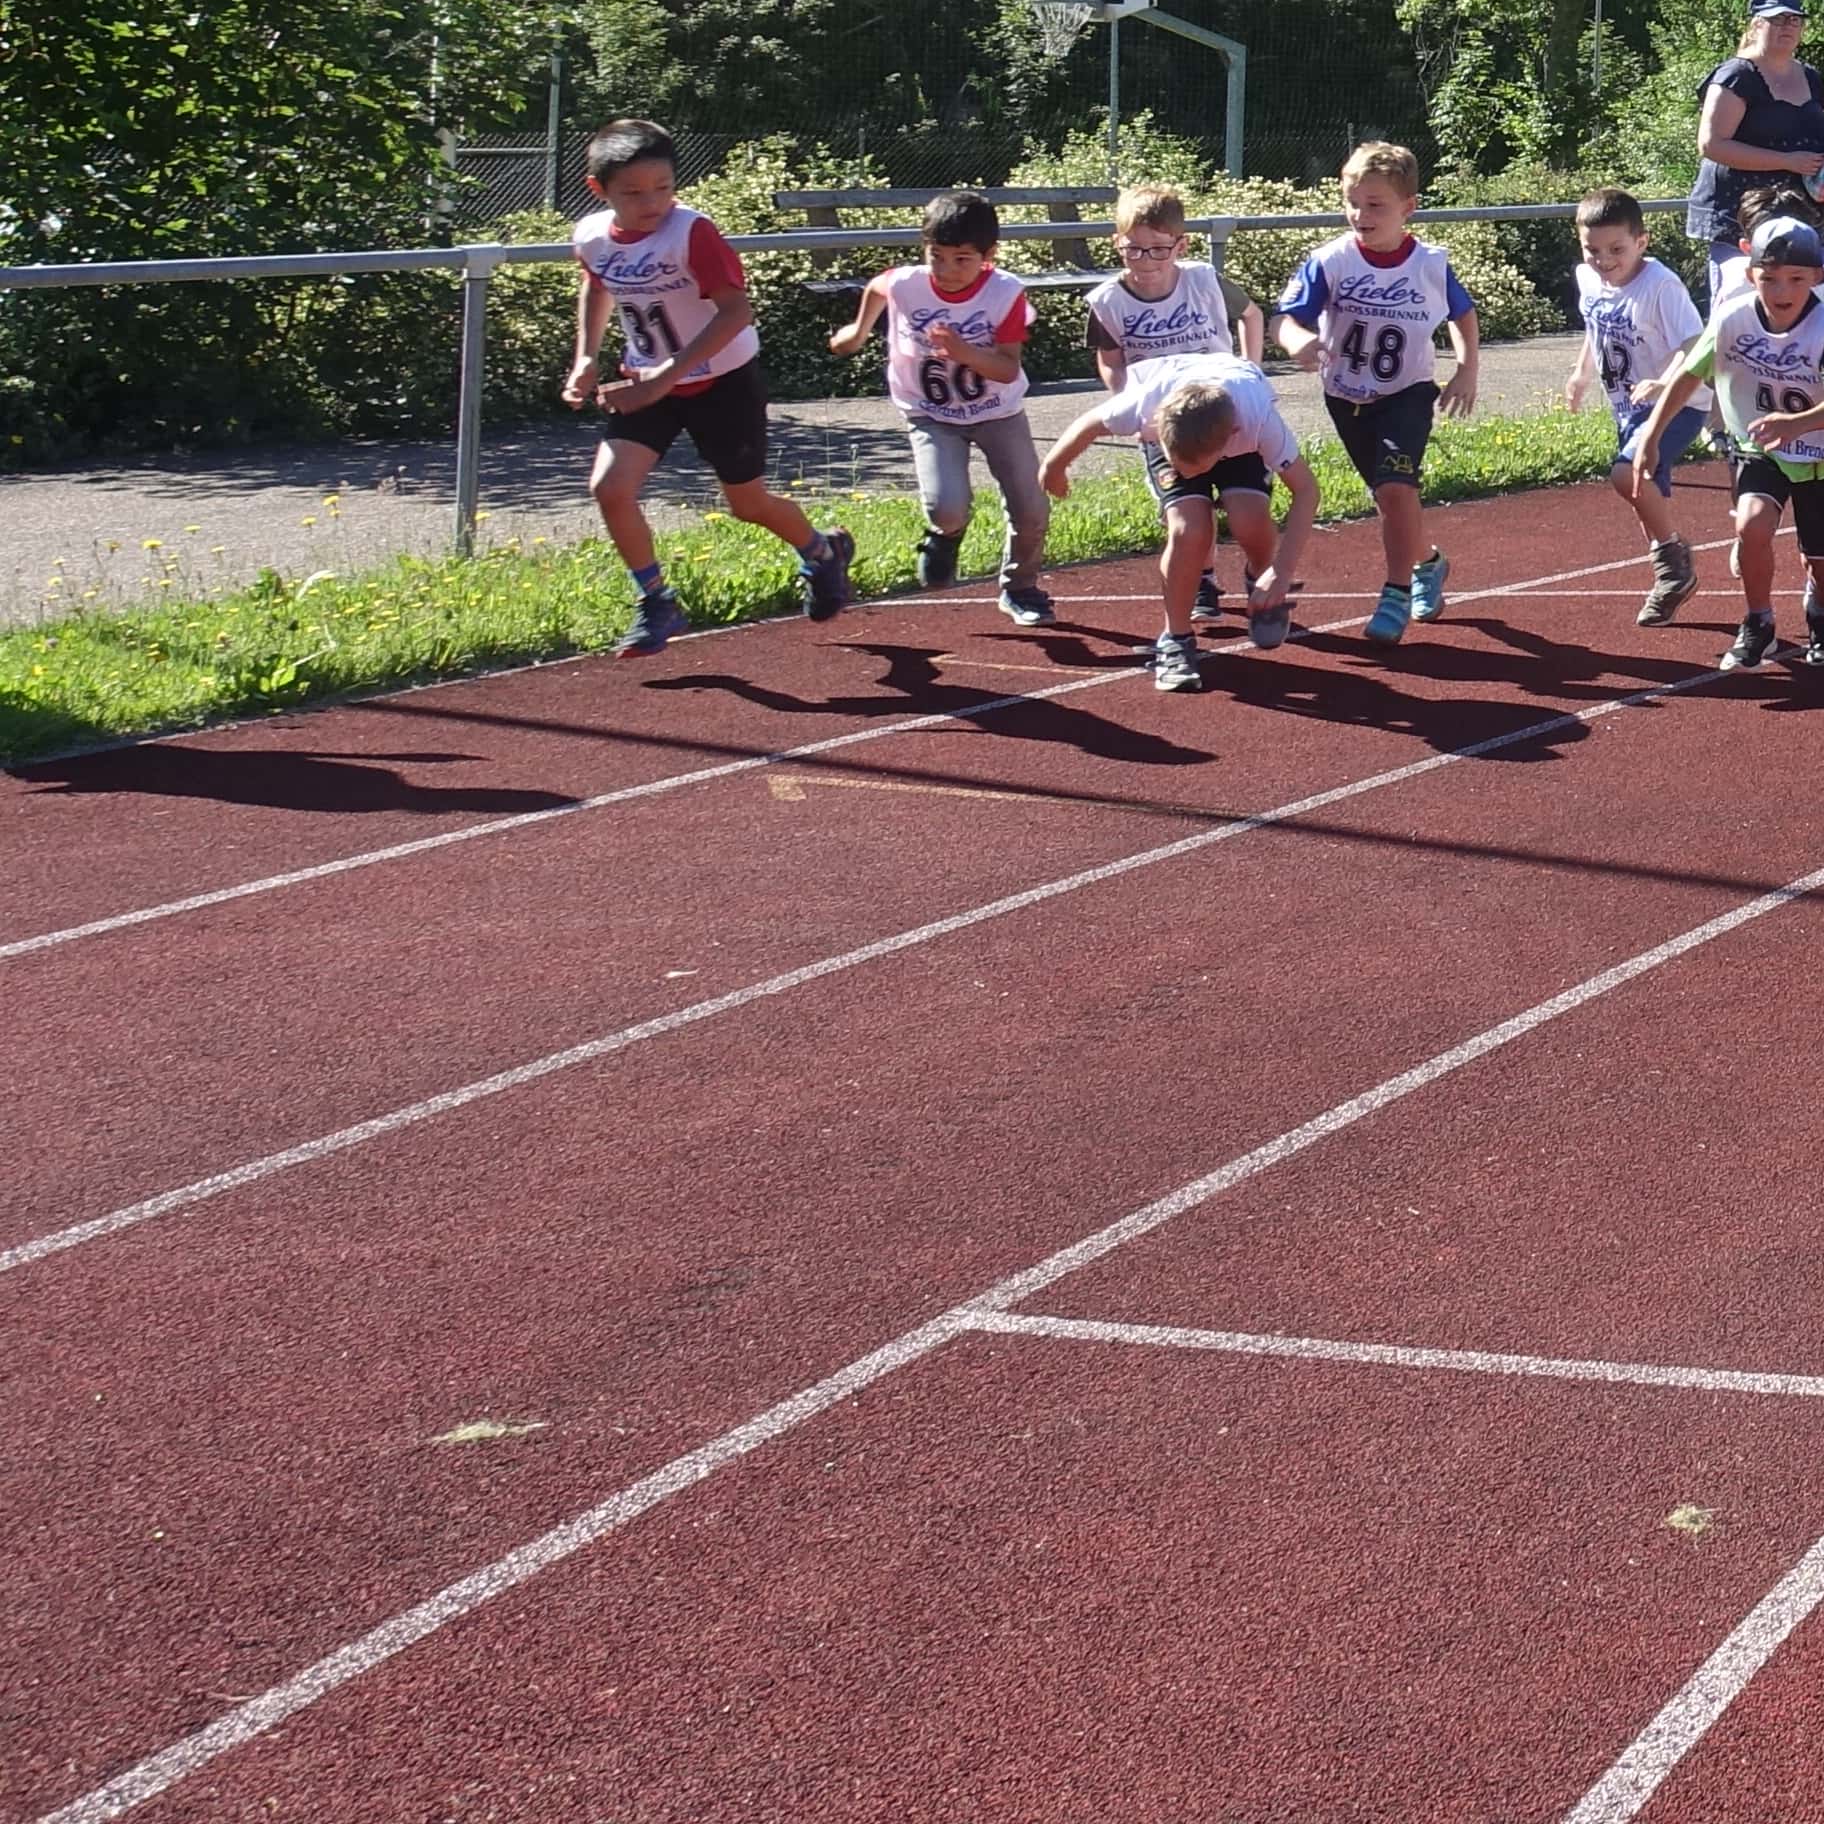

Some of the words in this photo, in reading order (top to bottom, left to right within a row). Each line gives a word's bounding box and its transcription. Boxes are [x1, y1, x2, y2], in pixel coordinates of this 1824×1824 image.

[595, 251, 678, 285] Lieler
[1338, 274, 1426, 307] Lieler
[619, 300, 684, 358] 31
[1120, 302, 1209, 339] Lieler
[1340, 319, 1408, 383] 48
[1729, 333, 1813, 373] Lieler
[920, 356, 987, 405] 60
